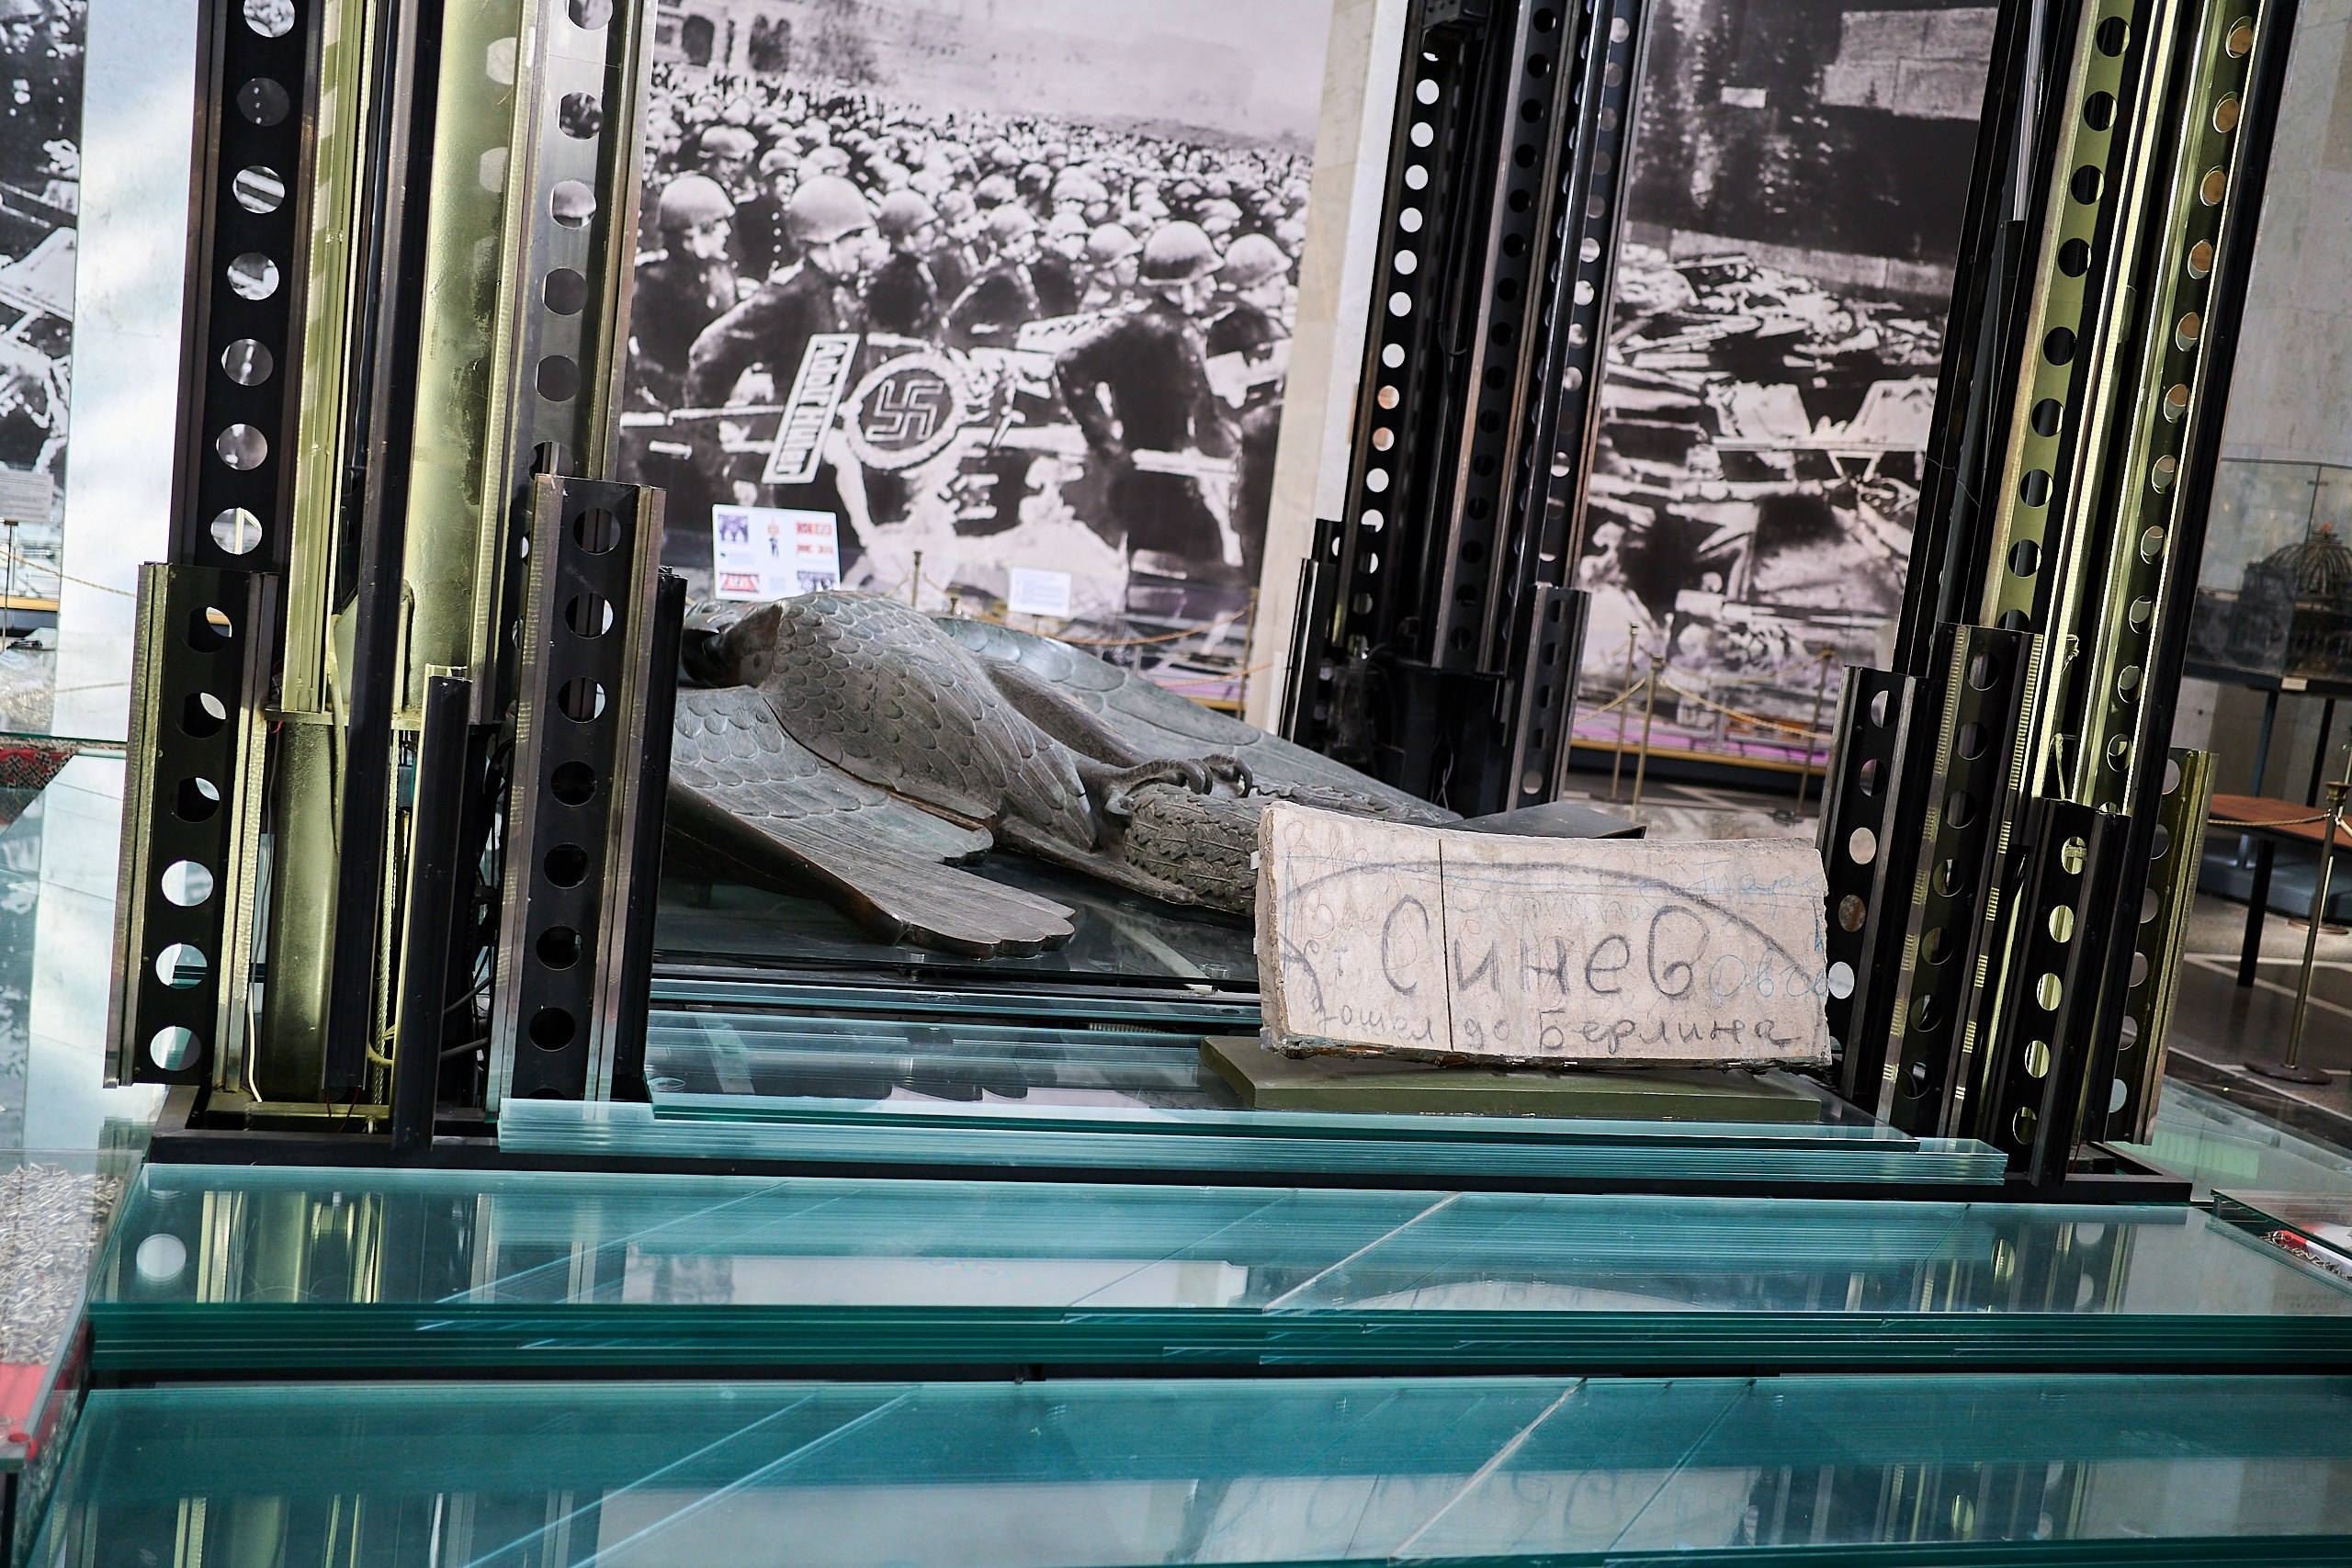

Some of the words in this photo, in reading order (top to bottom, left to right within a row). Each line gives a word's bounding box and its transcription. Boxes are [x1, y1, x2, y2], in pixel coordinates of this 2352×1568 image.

[1382, 893, 1710, 1000] Синев
[1464, 1018, 1510, 1051] до
[1538, 1008, 1802, 1055] Берлина
